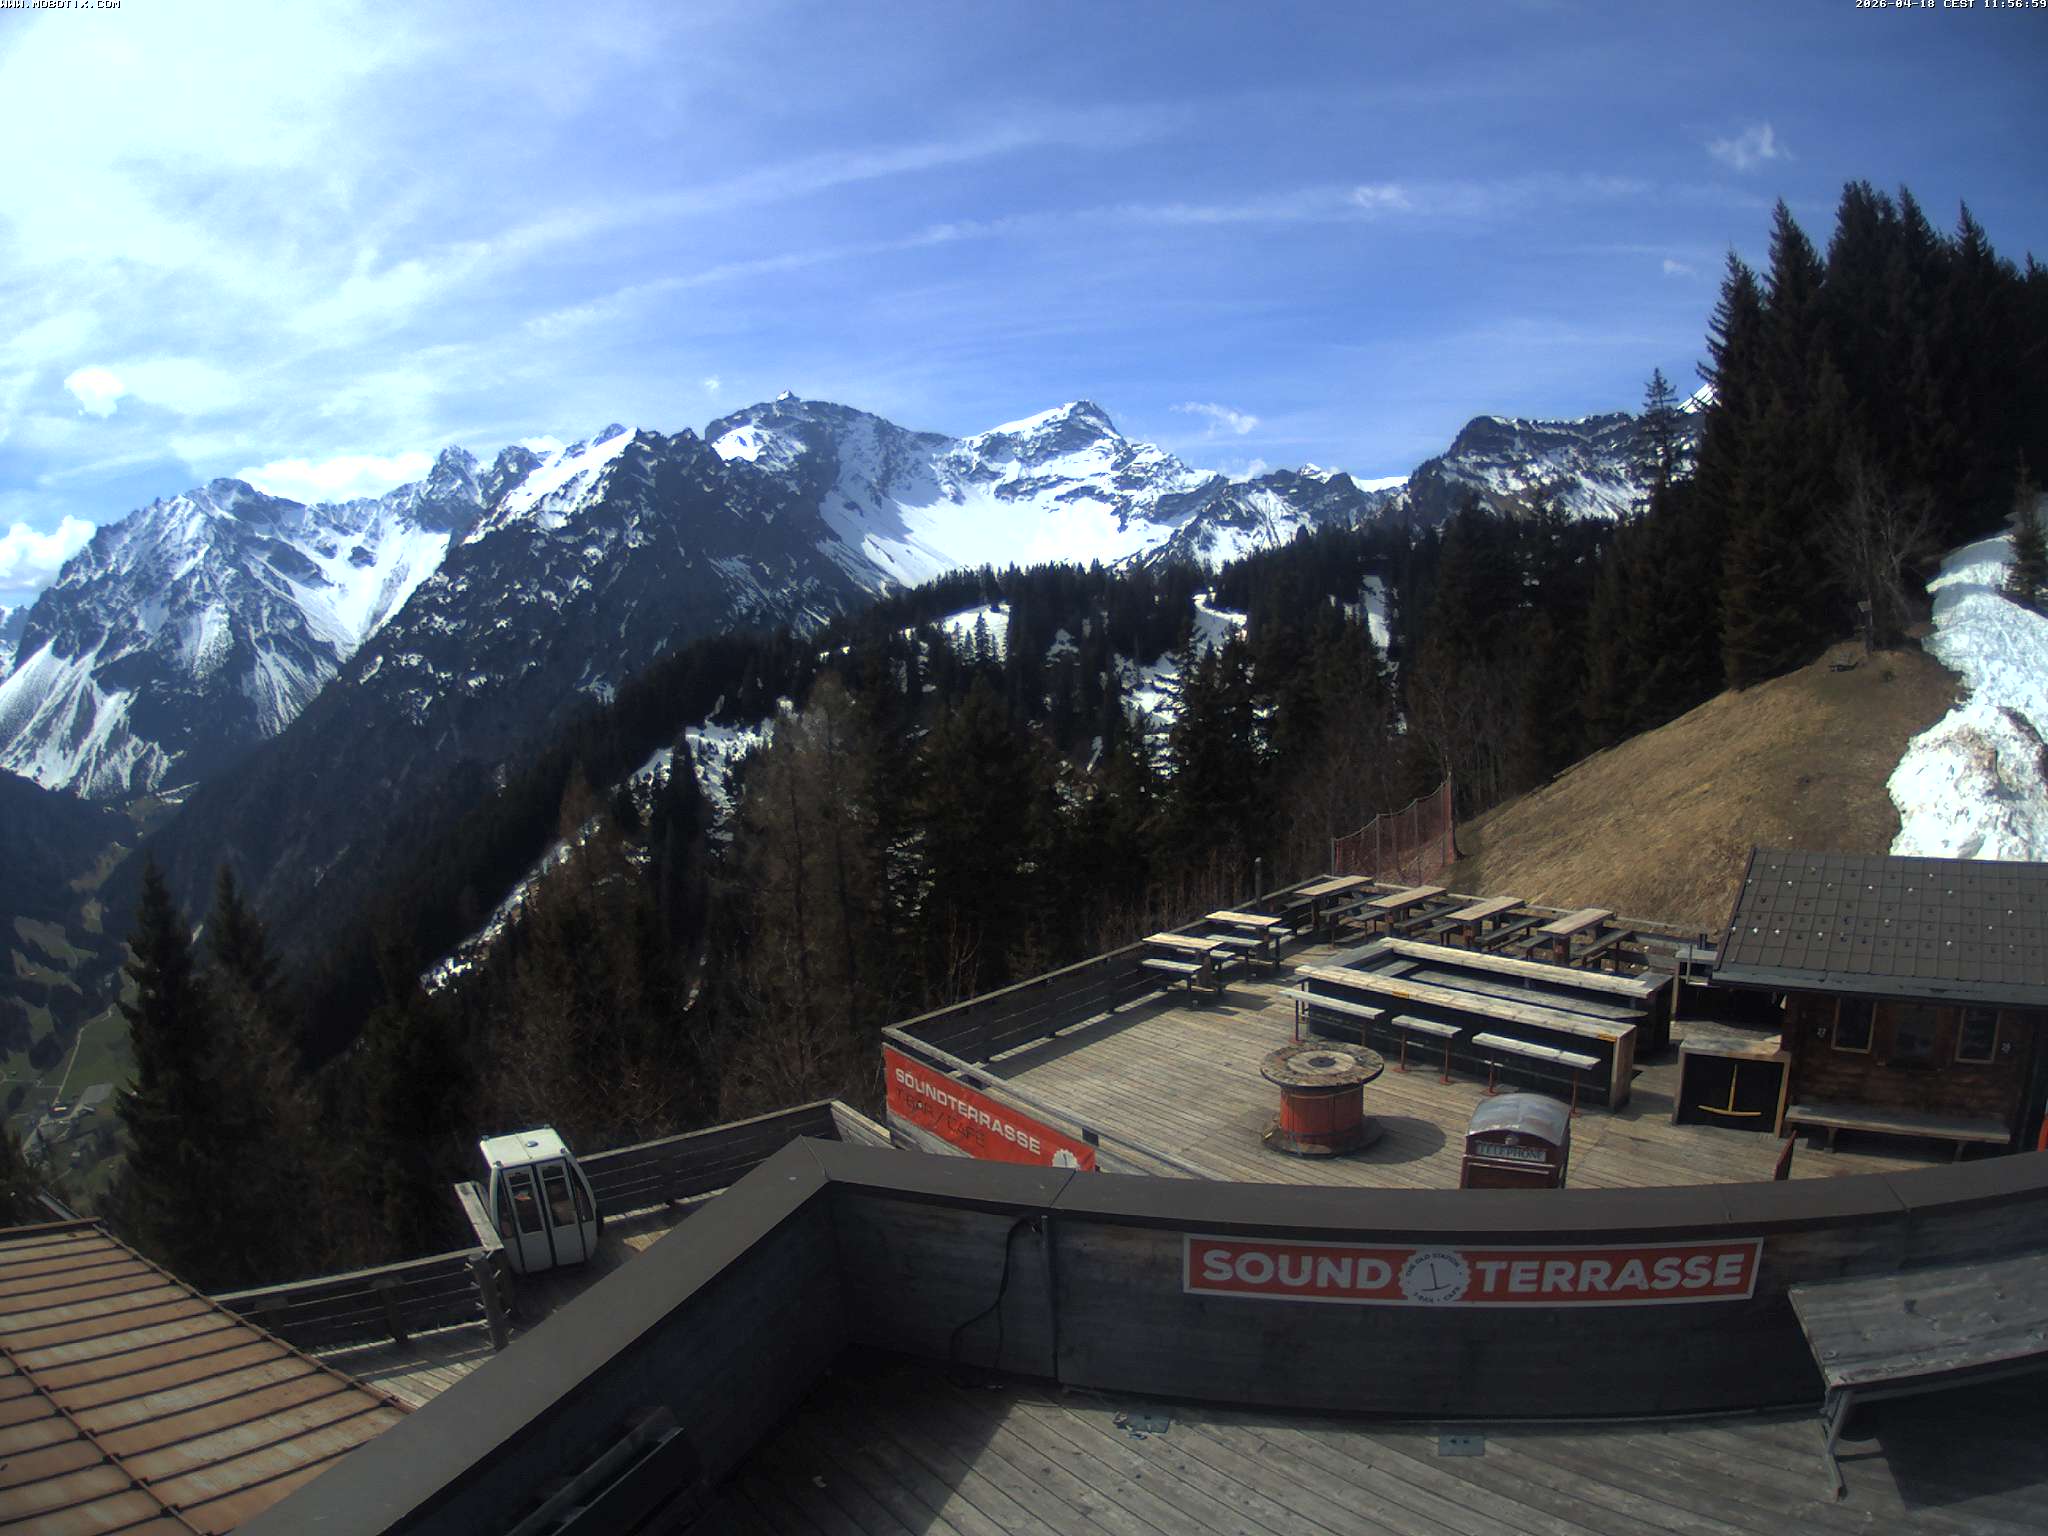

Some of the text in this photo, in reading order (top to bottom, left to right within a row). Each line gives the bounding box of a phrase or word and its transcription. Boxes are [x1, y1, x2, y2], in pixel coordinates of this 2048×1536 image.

[895, 1067, 1041, 1156] SOUNDTERRASSE
[1477, 1143, 1543, 1160] TELEPHONE
[1202, 1249, 1746, 1293] SOUND TERRASSE
